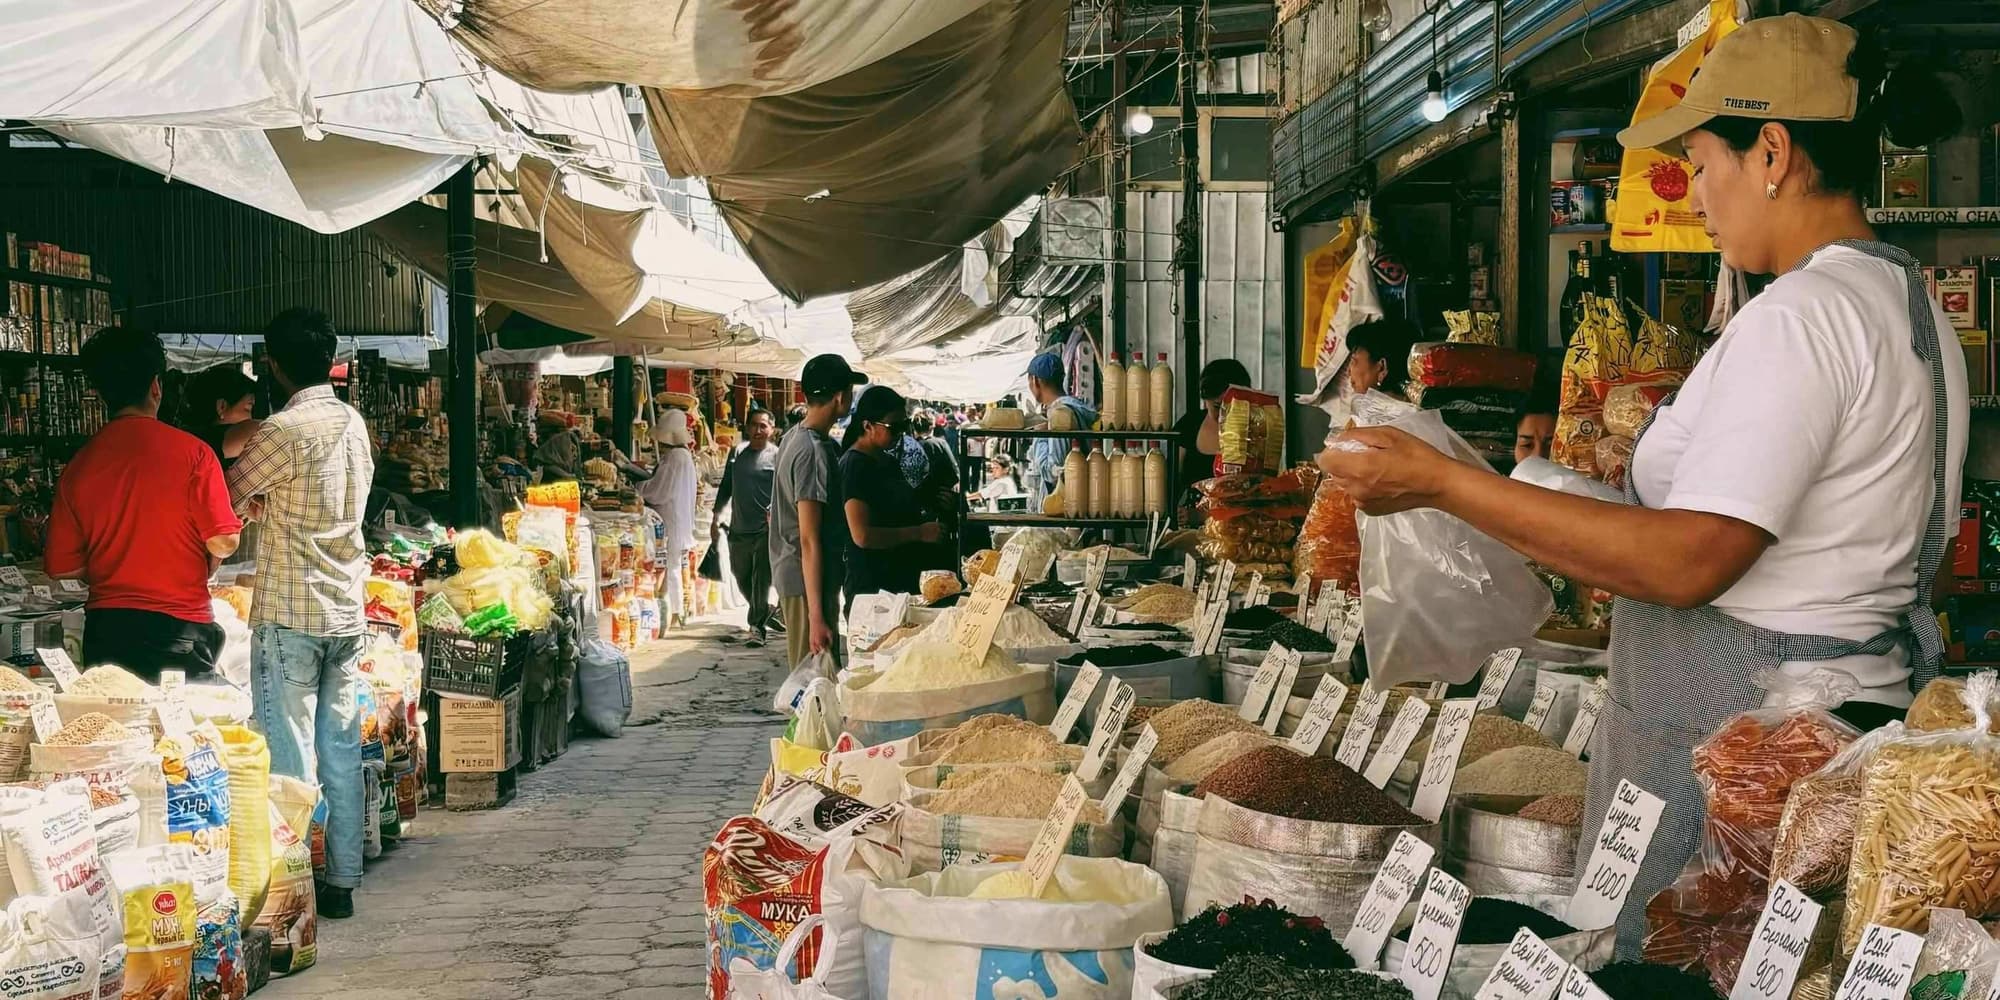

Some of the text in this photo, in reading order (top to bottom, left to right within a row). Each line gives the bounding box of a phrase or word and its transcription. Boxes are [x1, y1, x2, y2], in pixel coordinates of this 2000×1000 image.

[1874, 210, 1957, 223] CHAMPION
[1587, 863, 1627, 901] 1000
[761, 901, 812, 922] МУКА
[1772, 885, 1806, 924] Чай
[1411, 936, 1443, 978] 500
[1750, 958, 1784, 997] 900
